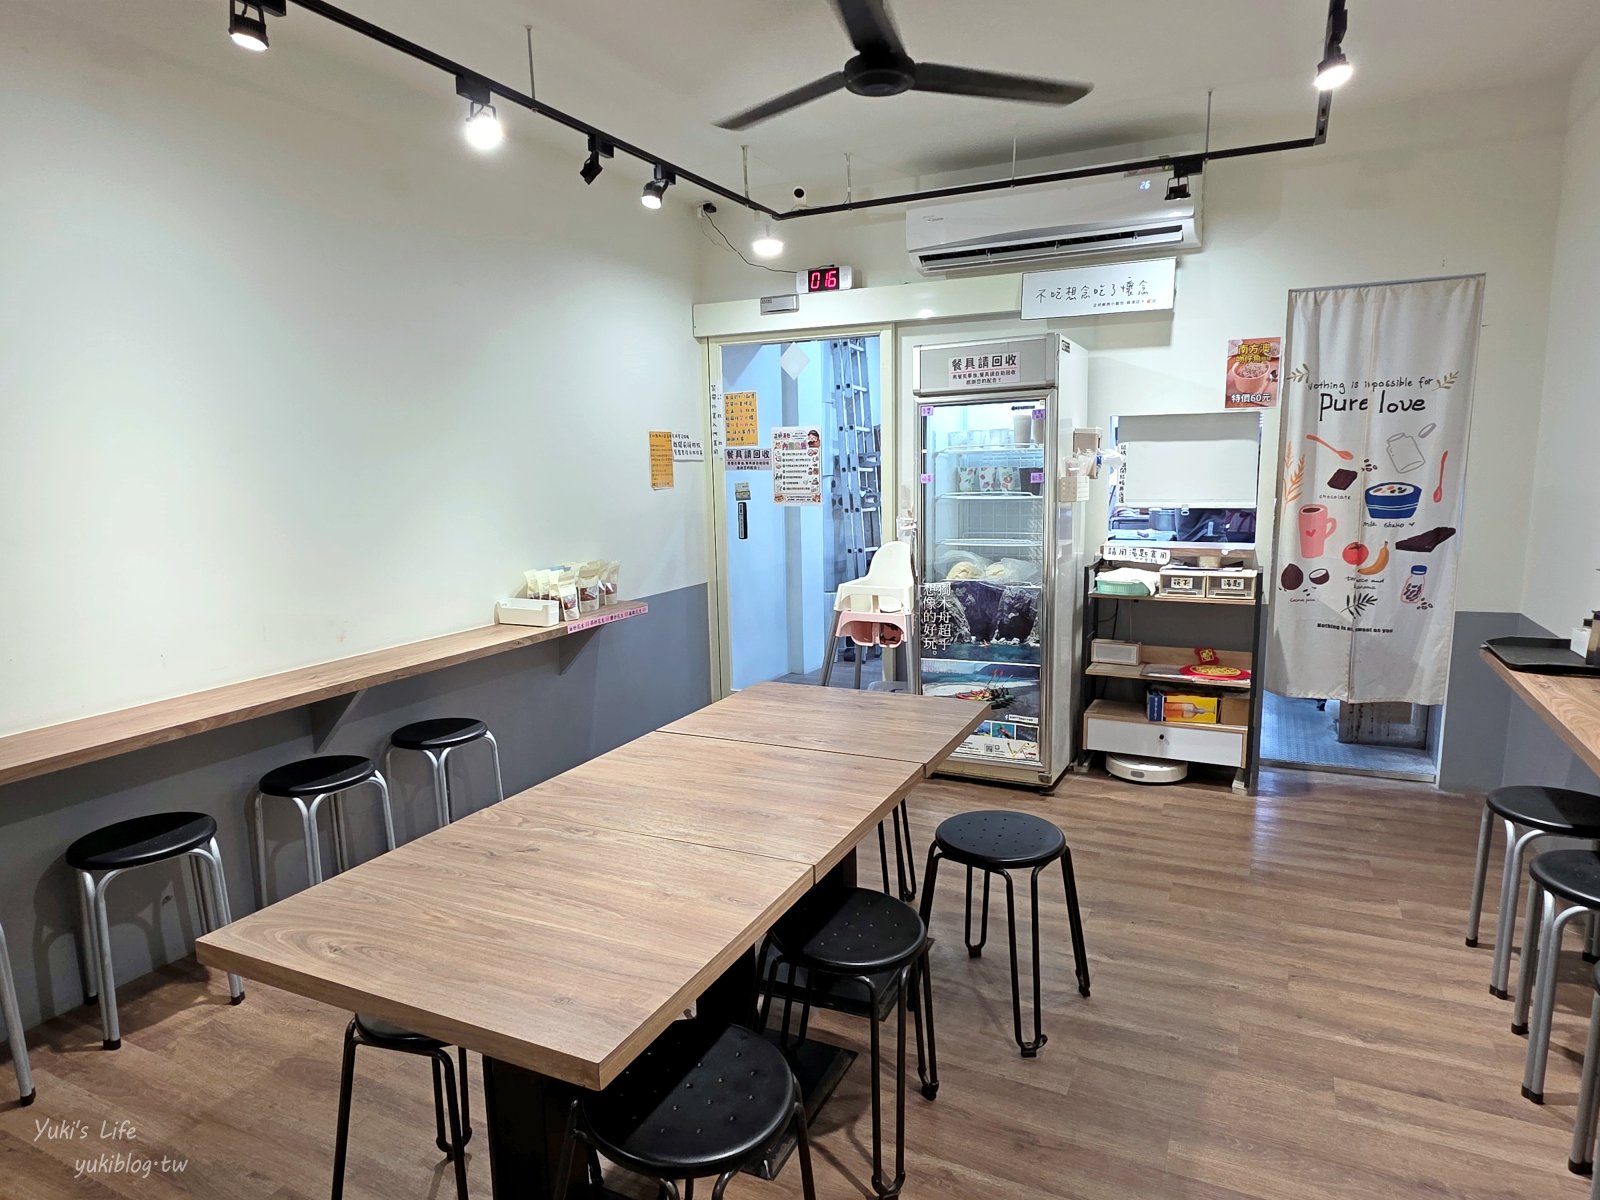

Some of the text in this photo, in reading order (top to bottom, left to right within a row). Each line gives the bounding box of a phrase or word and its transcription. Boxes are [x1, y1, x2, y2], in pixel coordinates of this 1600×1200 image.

[1238, 342, 1271, 354] 南方澳
[951, 353, 1017, 371] 餐具請回收
[1350, 380, 1359, 388] is
[1364, 376, 1413, 392] ipossible
[1418, 376, 1434, 389] for
[1231, 393, 1271, 403] 特價60元
[1378, 389, 1426, 413] love
[726, 449, 770, 459] 餐具請回收
[937, 582, 951, 651] 獨木舟超乎
